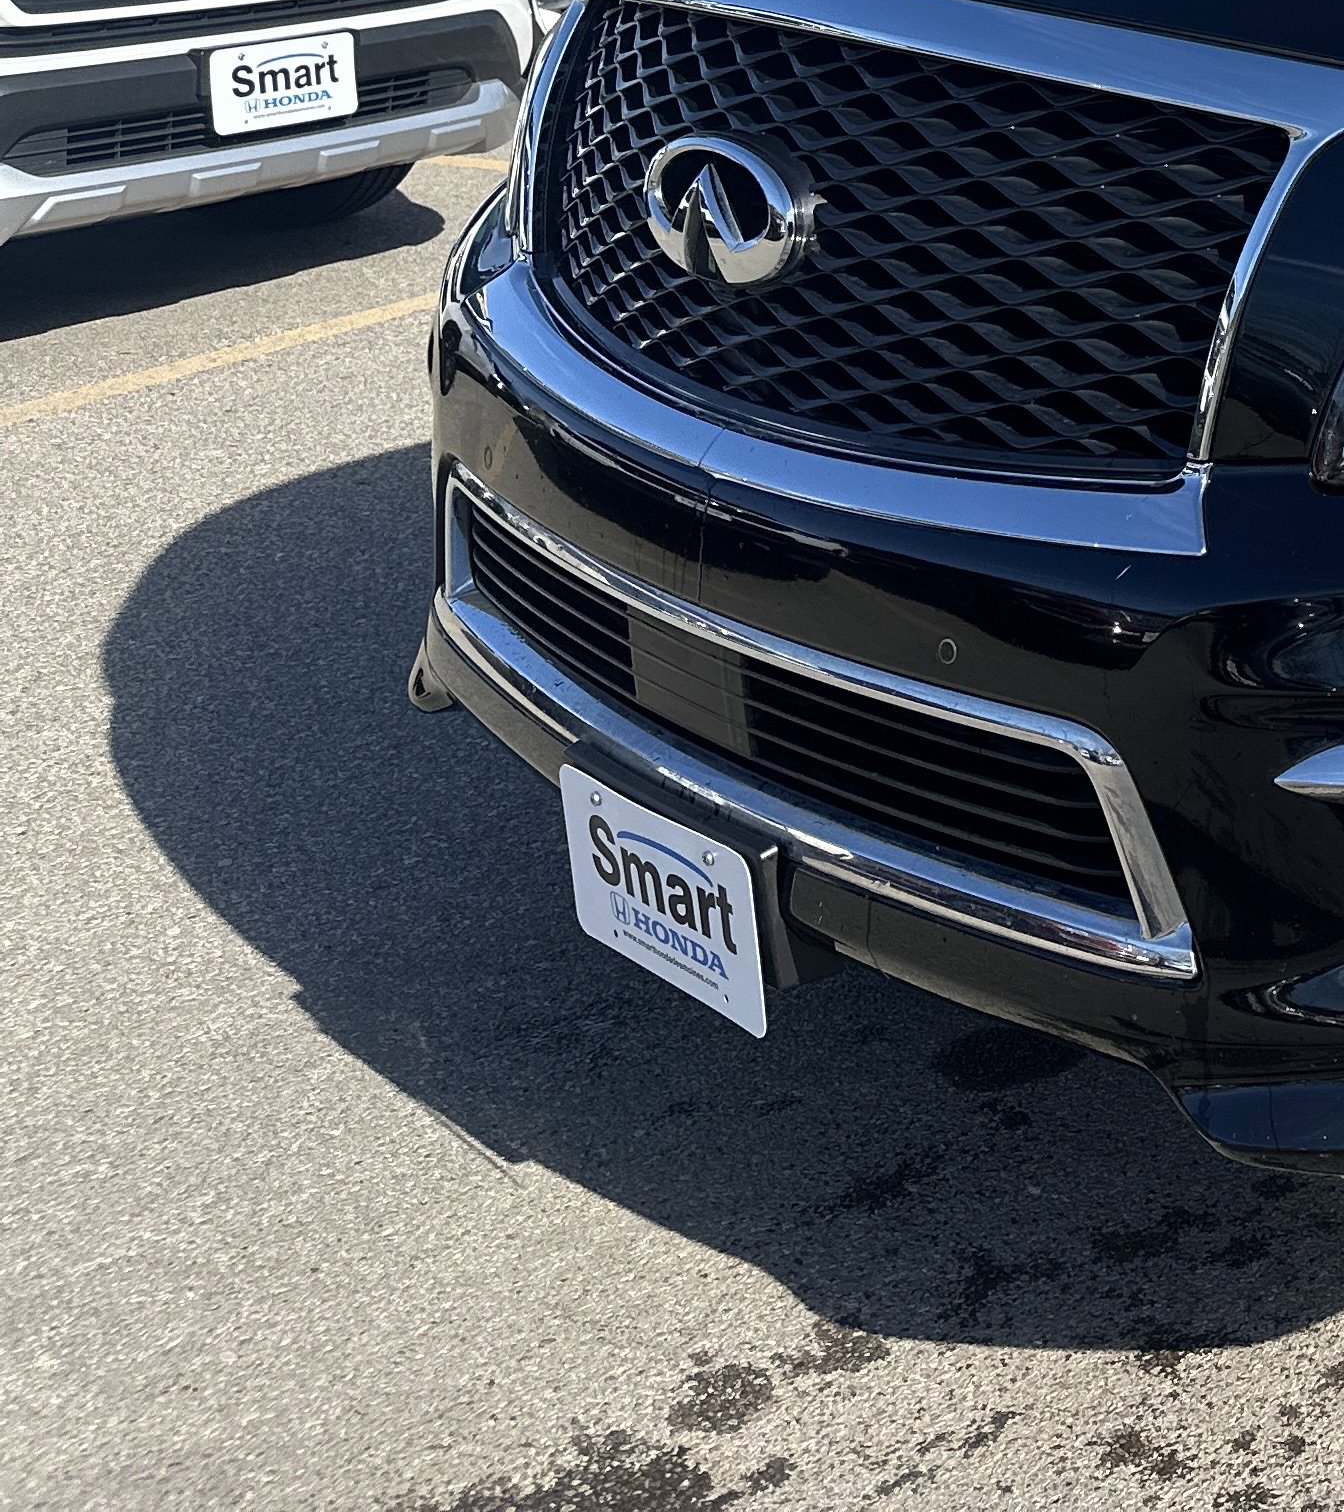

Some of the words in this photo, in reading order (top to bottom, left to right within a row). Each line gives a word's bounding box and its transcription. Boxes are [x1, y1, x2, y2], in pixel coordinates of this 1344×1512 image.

[231, 54, 339, 98] Smart
[263, 89, 333, 109] HONDA
[589, 814, 737, 955] Smart
[631, 907, 729, 980] HONDA
